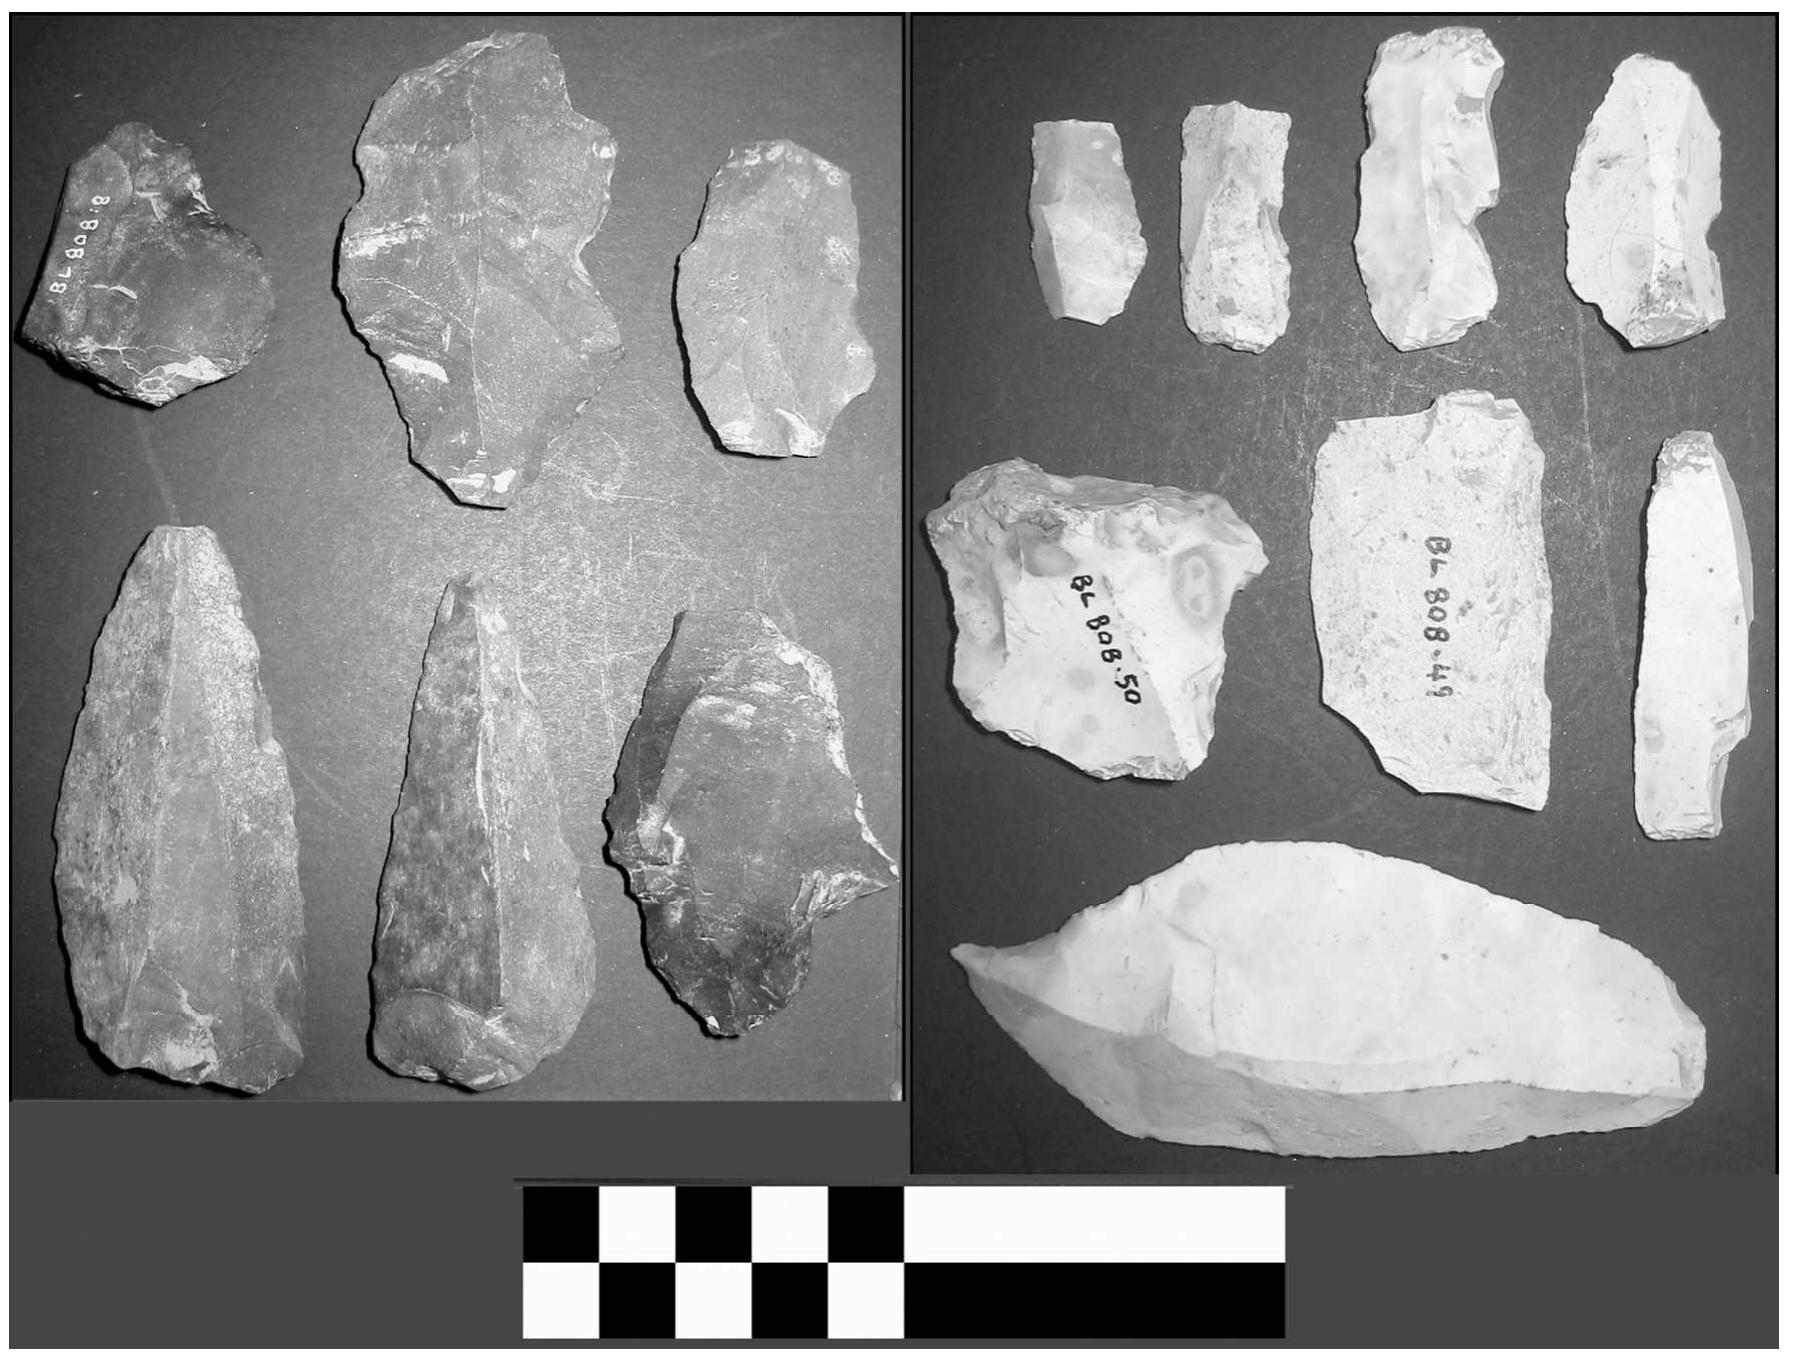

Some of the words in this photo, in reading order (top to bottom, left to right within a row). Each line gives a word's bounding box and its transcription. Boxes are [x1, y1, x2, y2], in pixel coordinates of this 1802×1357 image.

[49, 265, 72, 294] BL
[1424, 535, 1452, 579] BL
[1070, 574, 1096, 609] BL
